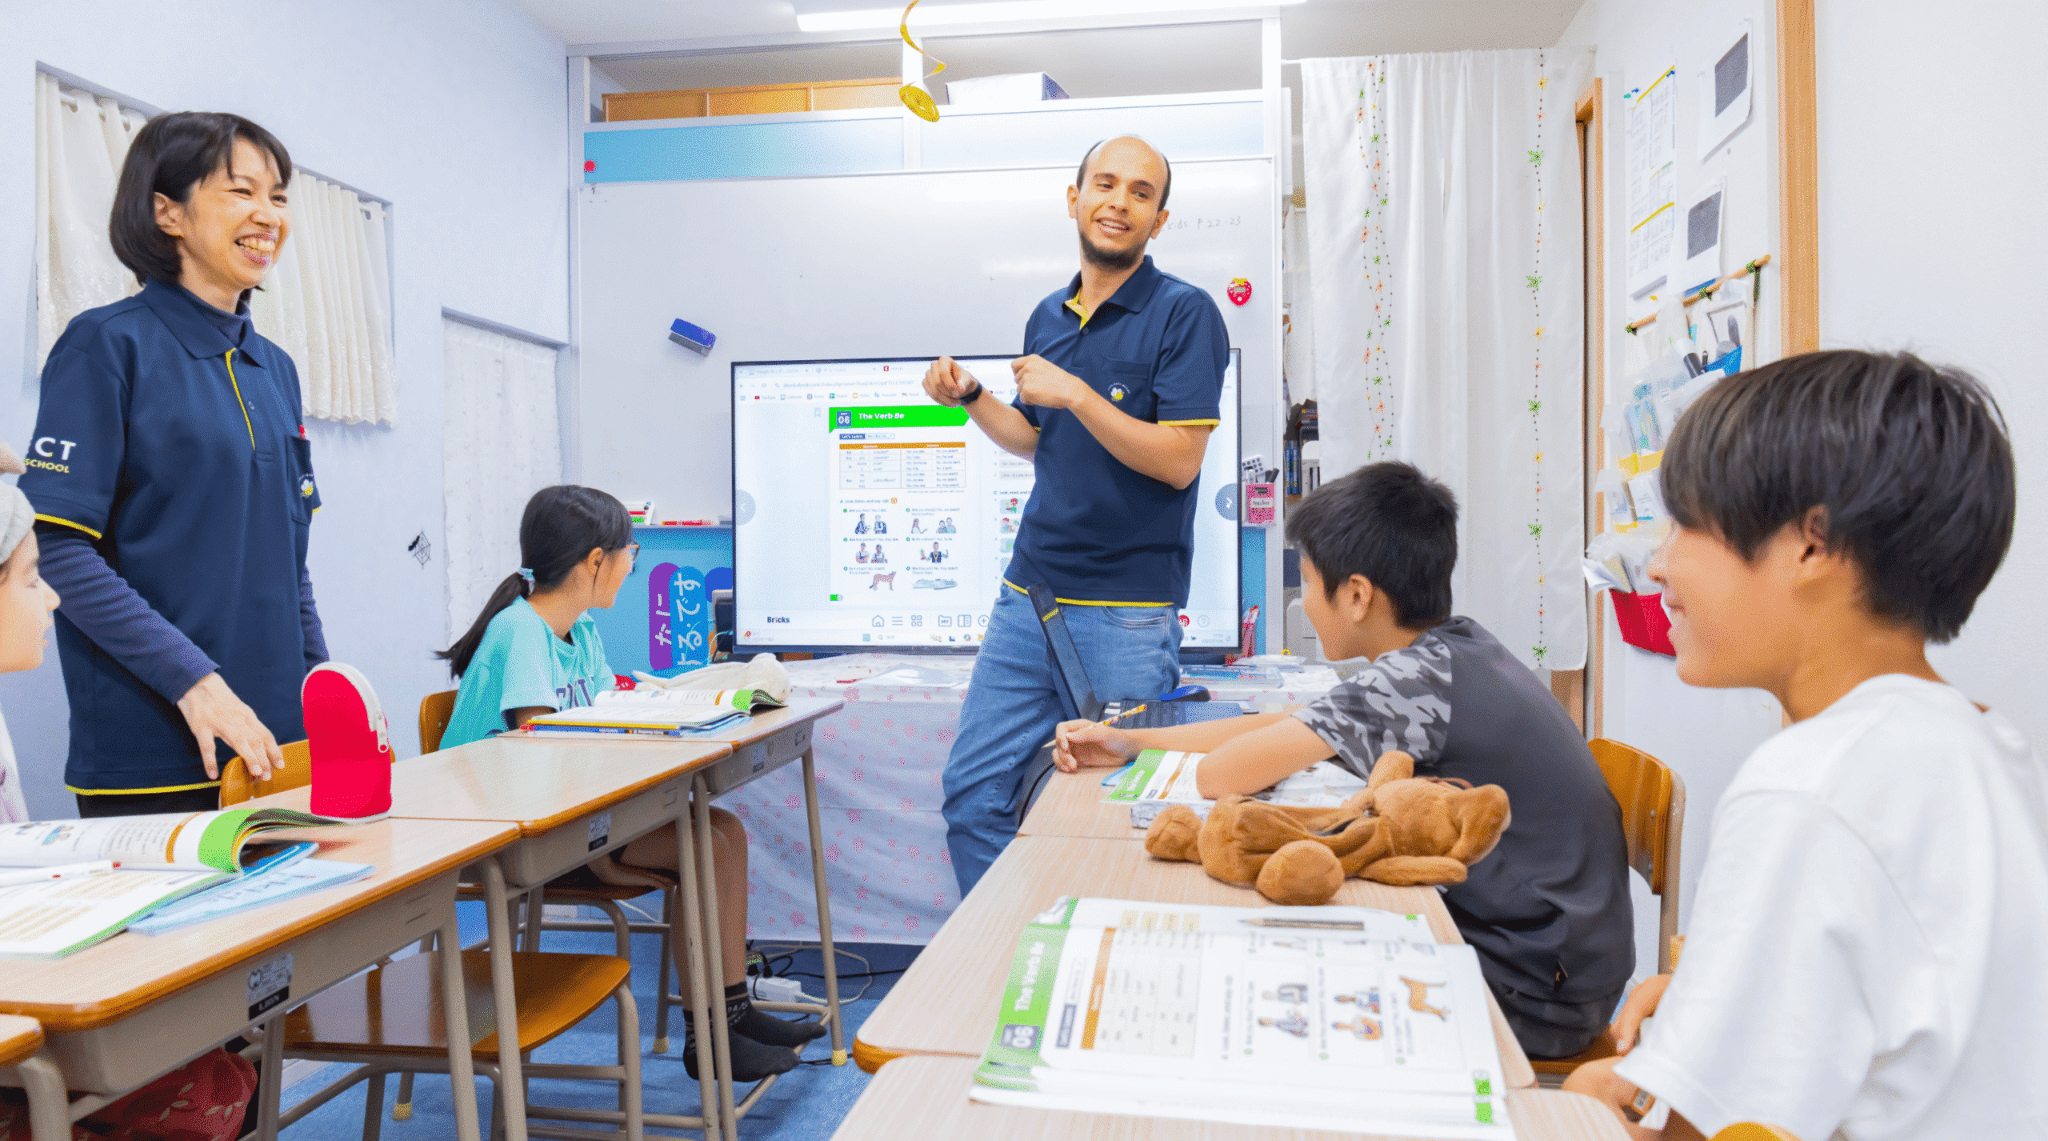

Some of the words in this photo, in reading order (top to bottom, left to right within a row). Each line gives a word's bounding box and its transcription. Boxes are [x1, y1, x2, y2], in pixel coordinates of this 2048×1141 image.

[838, 416, 850, 424] 06
[858, 412, 873, 420] The
[34, 436, 77, 461] CT
[24, 458, 70, 474] SCHOOL
[1012, 1026, 1034, 1047] 06
